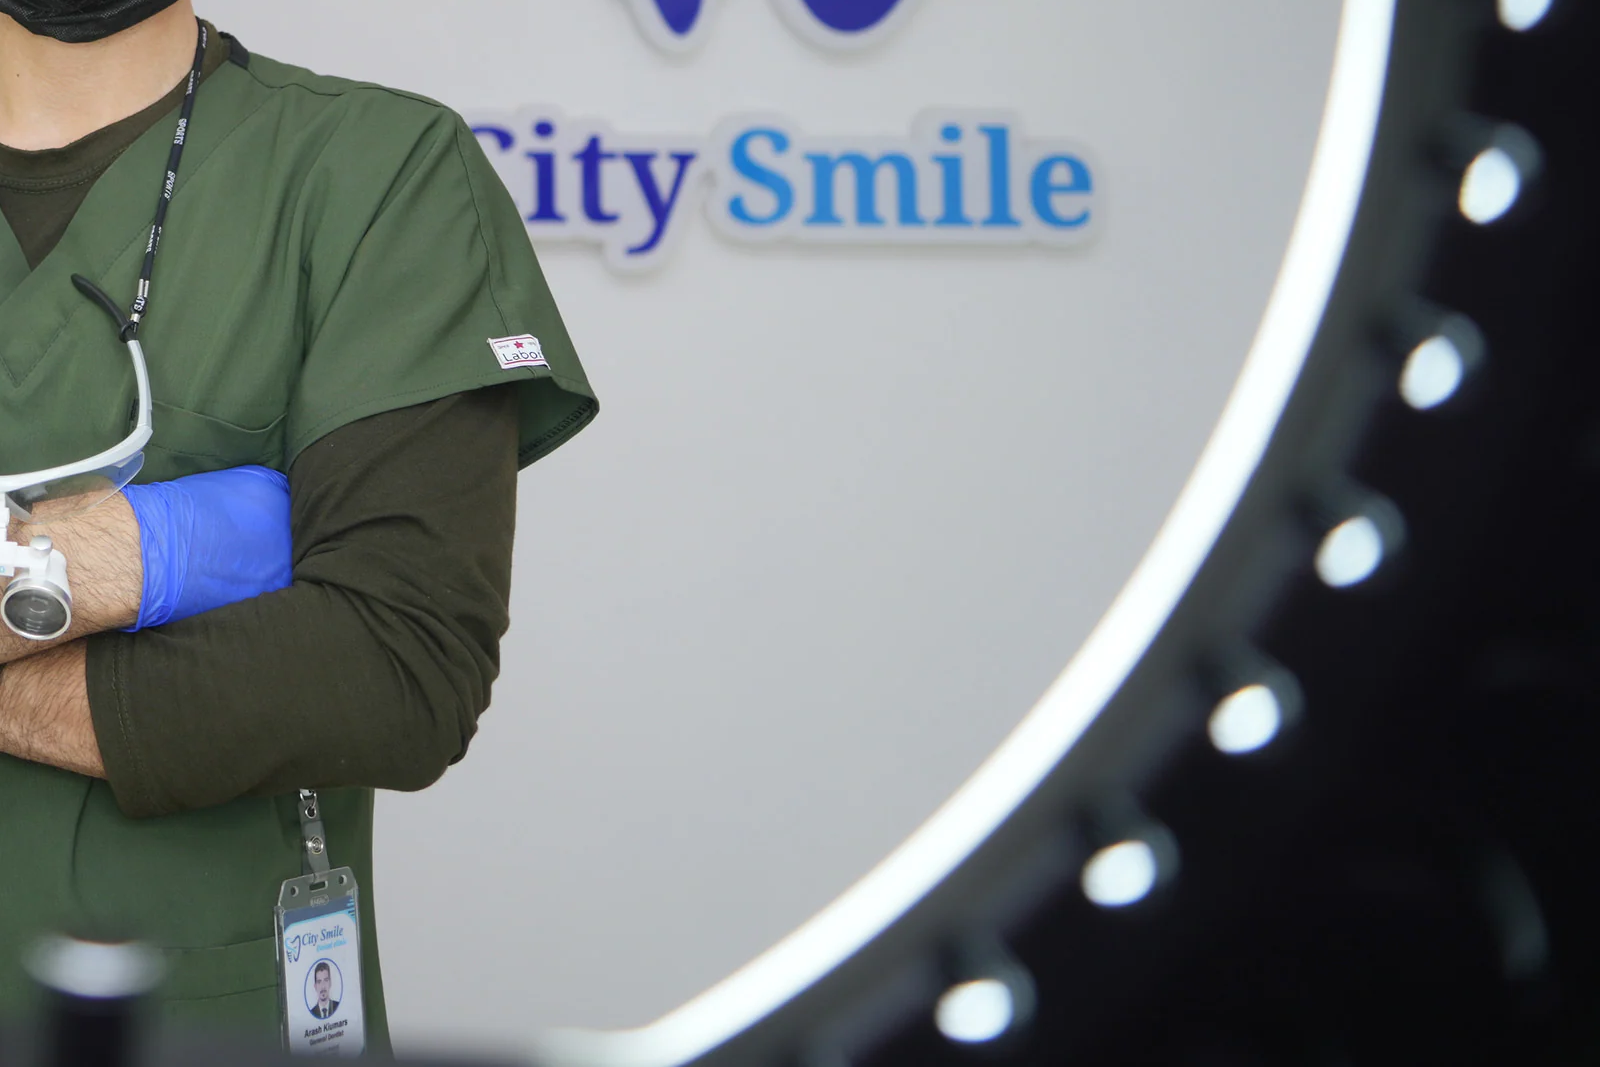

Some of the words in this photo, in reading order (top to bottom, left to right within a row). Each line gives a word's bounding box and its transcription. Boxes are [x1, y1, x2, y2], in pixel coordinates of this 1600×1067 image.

[173, 118, 187, 145] SPORTS
[164, 170, 176, 201] SPORTS
[728, 124, 1093, 227] Smile
[302, 932, 318, 946] City
[320, 924, 344, 941] Smile
[304, 1026, 322, 1038] Arash
